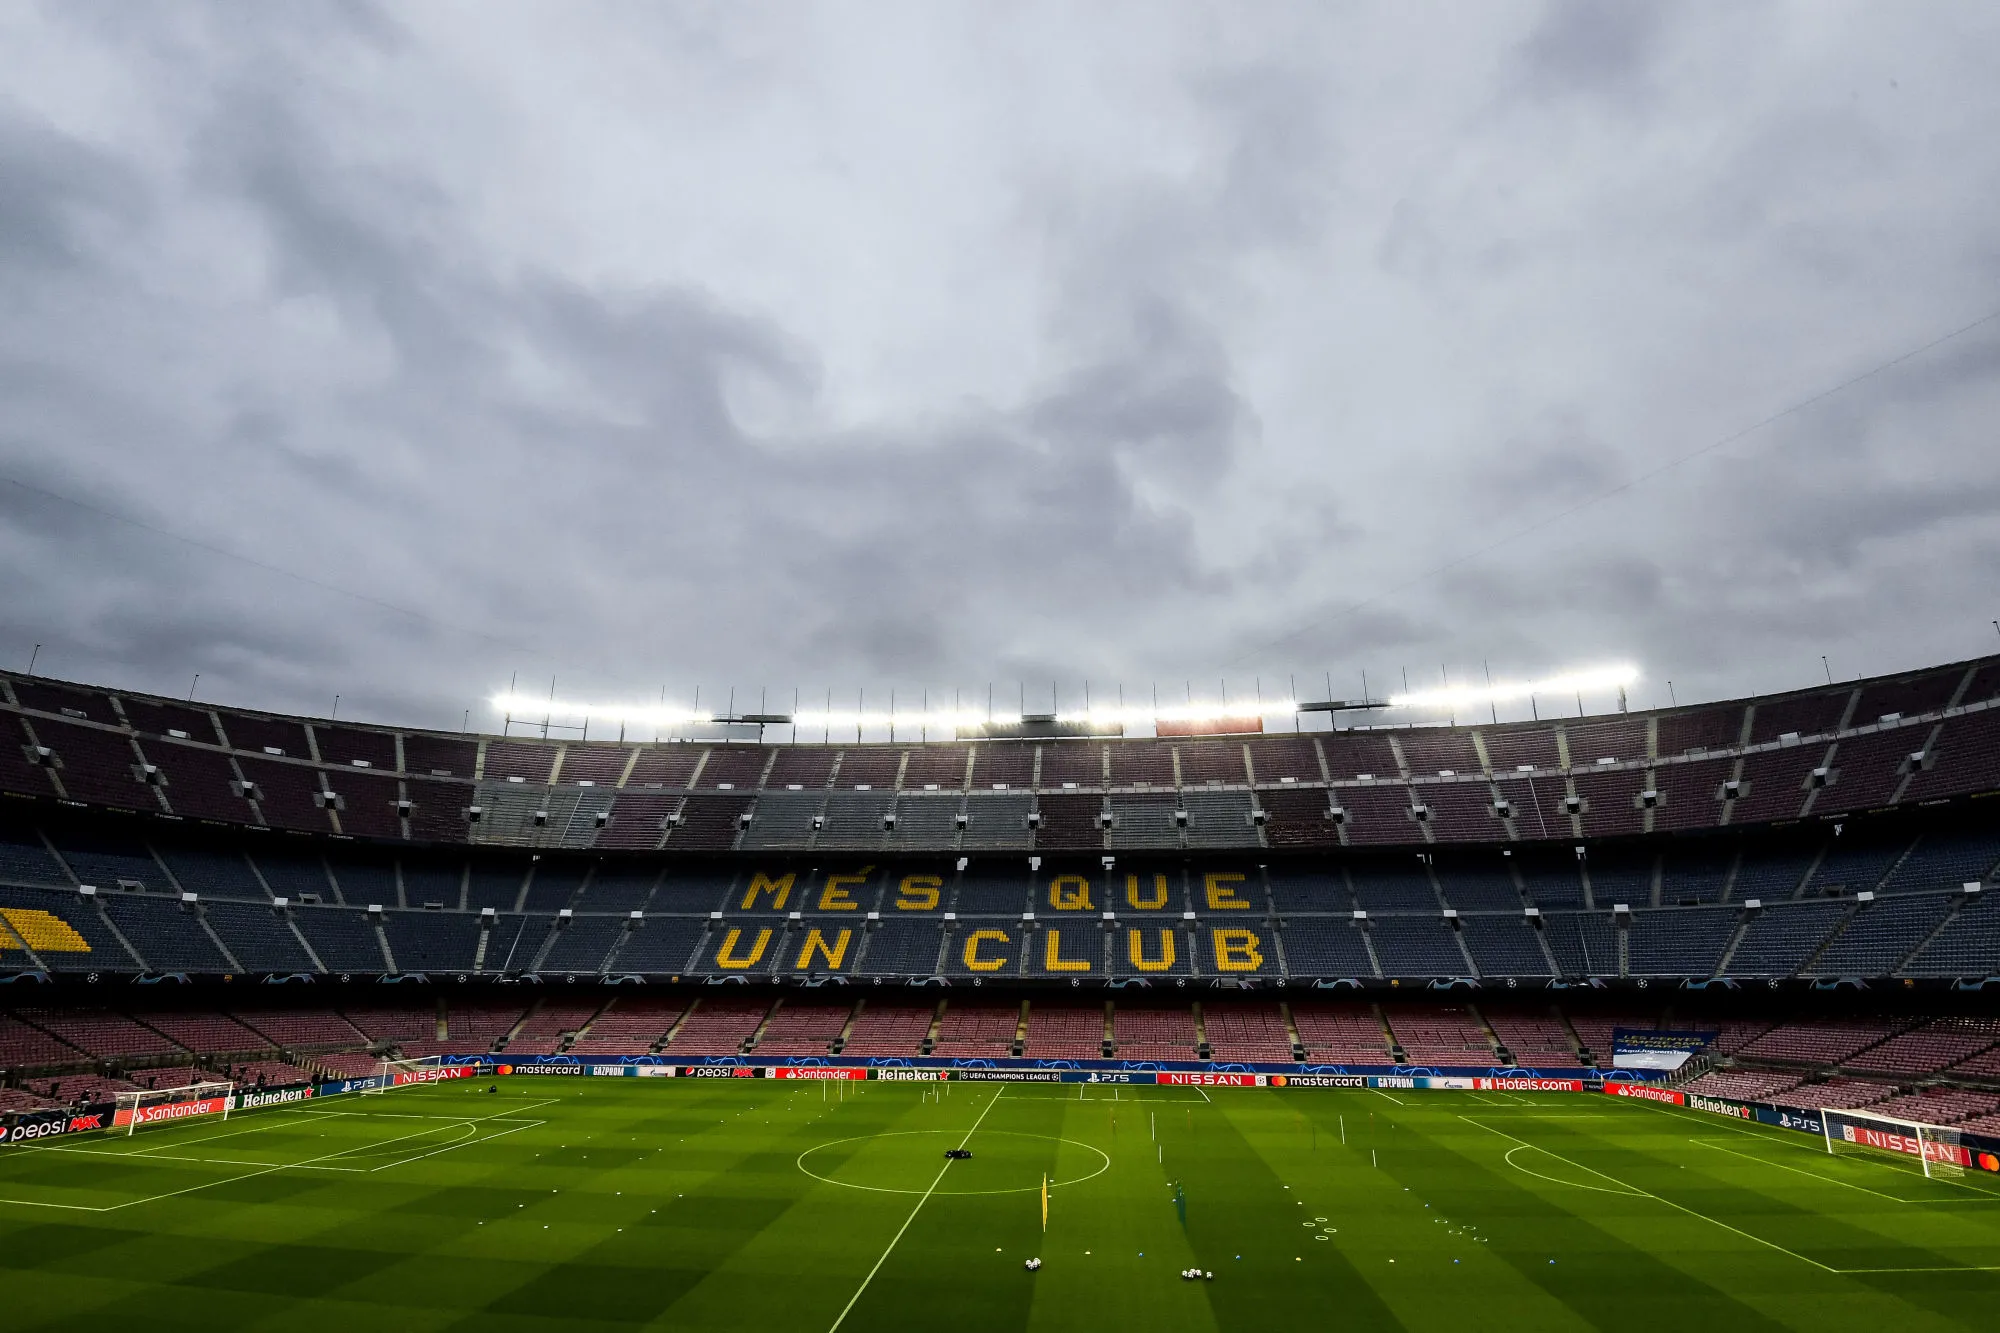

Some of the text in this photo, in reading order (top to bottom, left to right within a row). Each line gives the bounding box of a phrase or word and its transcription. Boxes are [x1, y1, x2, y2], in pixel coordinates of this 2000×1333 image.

[741, 865, 1250, 910] MÉS QUE
[716, 929, 1264, 972] UN CLUB
[402, 1068, 461, 1083] NISSAN
[515, 1065, 580, 1075] mastercard
[593, 1067, 624, 1076] GAZPROM
[697, 1068, 755, 1077] pepsi MAX
[797, 1069, 851, 1079] Santander
[877, 1069, 938, 1080] Heineken
[353, 1079, 376, 1089] PS5
[1101, 1074, 1130, 1082] PS5
[1171, 1074, 1242, 1085] NISSAN
[1290, 1077, 1363, 1087] mastercard
[1378, 1078, 1414, 1088] GAZPROM
[1495, 1079, 1573, 1091] Hotels.com
[242, 1089, 302, 1107] Heineken
[1629, 1086, 1675, 1103] Santander
[145, 1102, 212, 1121] Santander
[1690, 1095, 1741, 1117] Heineken
[11, 1114, 103, 1142] pepsi MAX
[1793, 1117, 1820, 1132] PS5
[1866, 1130, 1955, 1161] NISSAN
